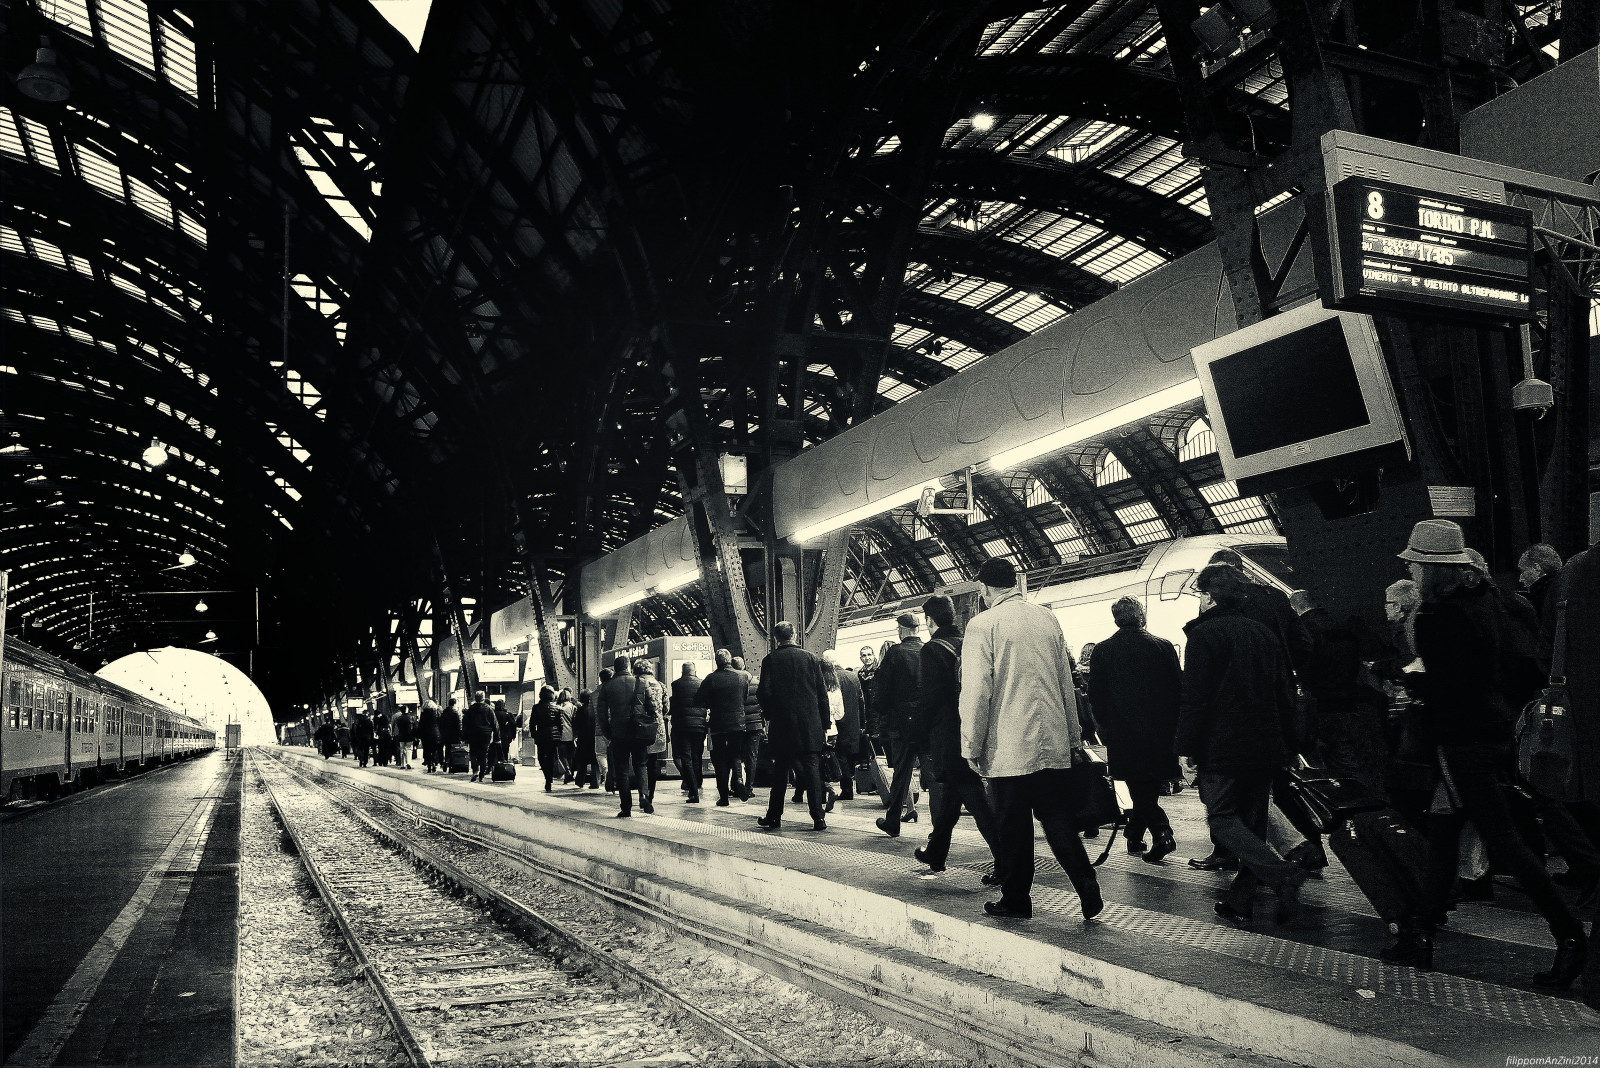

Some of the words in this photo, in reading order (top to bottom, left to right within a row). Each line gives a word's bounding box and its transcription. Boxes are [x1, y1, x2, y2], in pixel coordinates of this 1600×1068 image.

[1367, 191, 1384, 219] 8
[1418, 208, 1464, 233] TORINO
[1424, 279, 1459, 293] VIETATO
